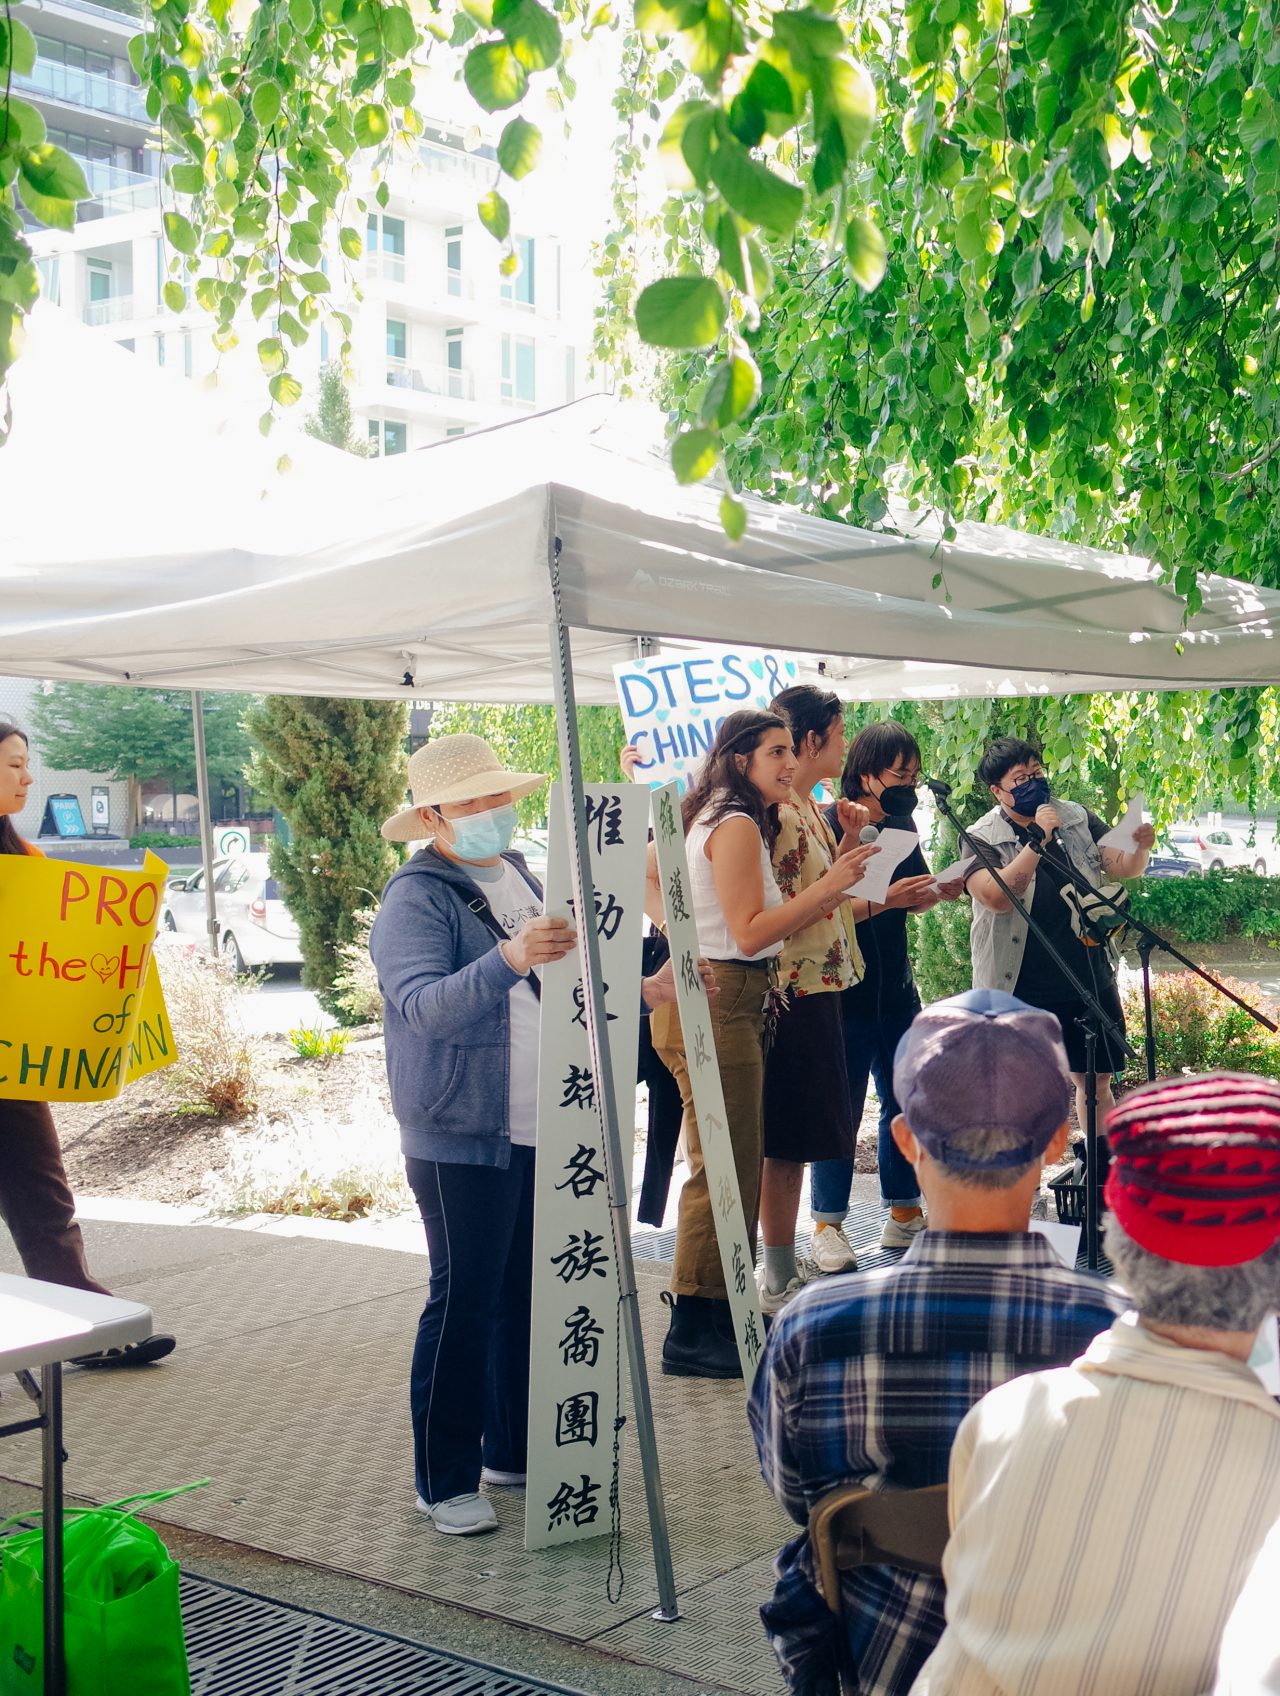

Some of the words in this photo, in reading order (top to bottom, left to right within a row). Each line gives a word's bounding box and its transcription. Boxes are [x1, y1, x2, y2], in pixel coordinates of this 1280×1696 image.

[619, 655, 751, 717] DTES
[629, 716, 727, 769] CHIN
[9, 941, 87, 982] the
[119, 943, 150, 990] H
[93, 993, 135, 1034] of
